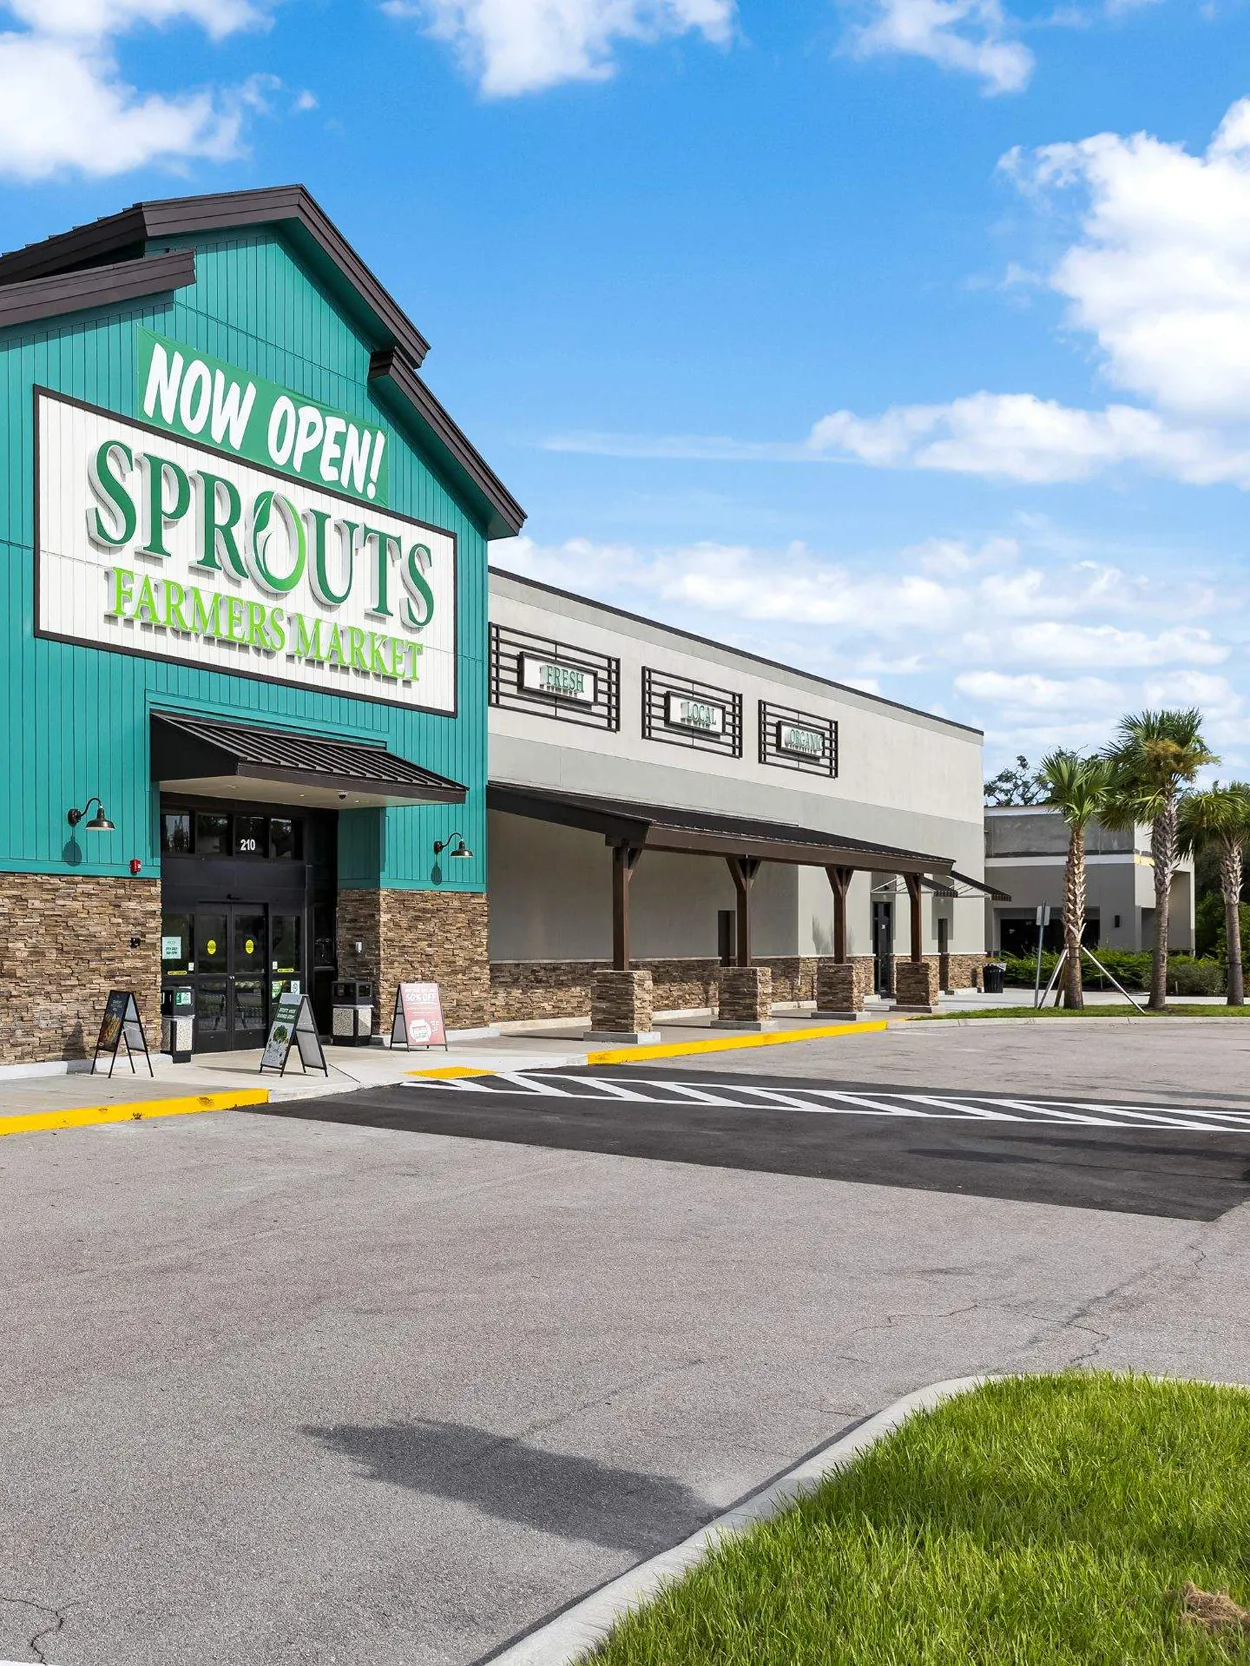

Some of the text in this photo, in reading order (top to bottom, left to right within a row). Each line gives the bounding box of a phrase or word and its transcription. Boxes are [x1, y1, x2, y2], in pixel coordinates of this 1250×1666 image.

[143, 342, 387, 499] NOW OPEN!
[90, 439, 435, 629] SPROUTS
[109, 566, 424, 682] FARMERS MARKET
[546, 664, 585, 694] FRESH
[686, 701, 717, 726] LOCAL
[789, 728, 824, 752] ORGANIC
[240, 838, 256, 851] 210
